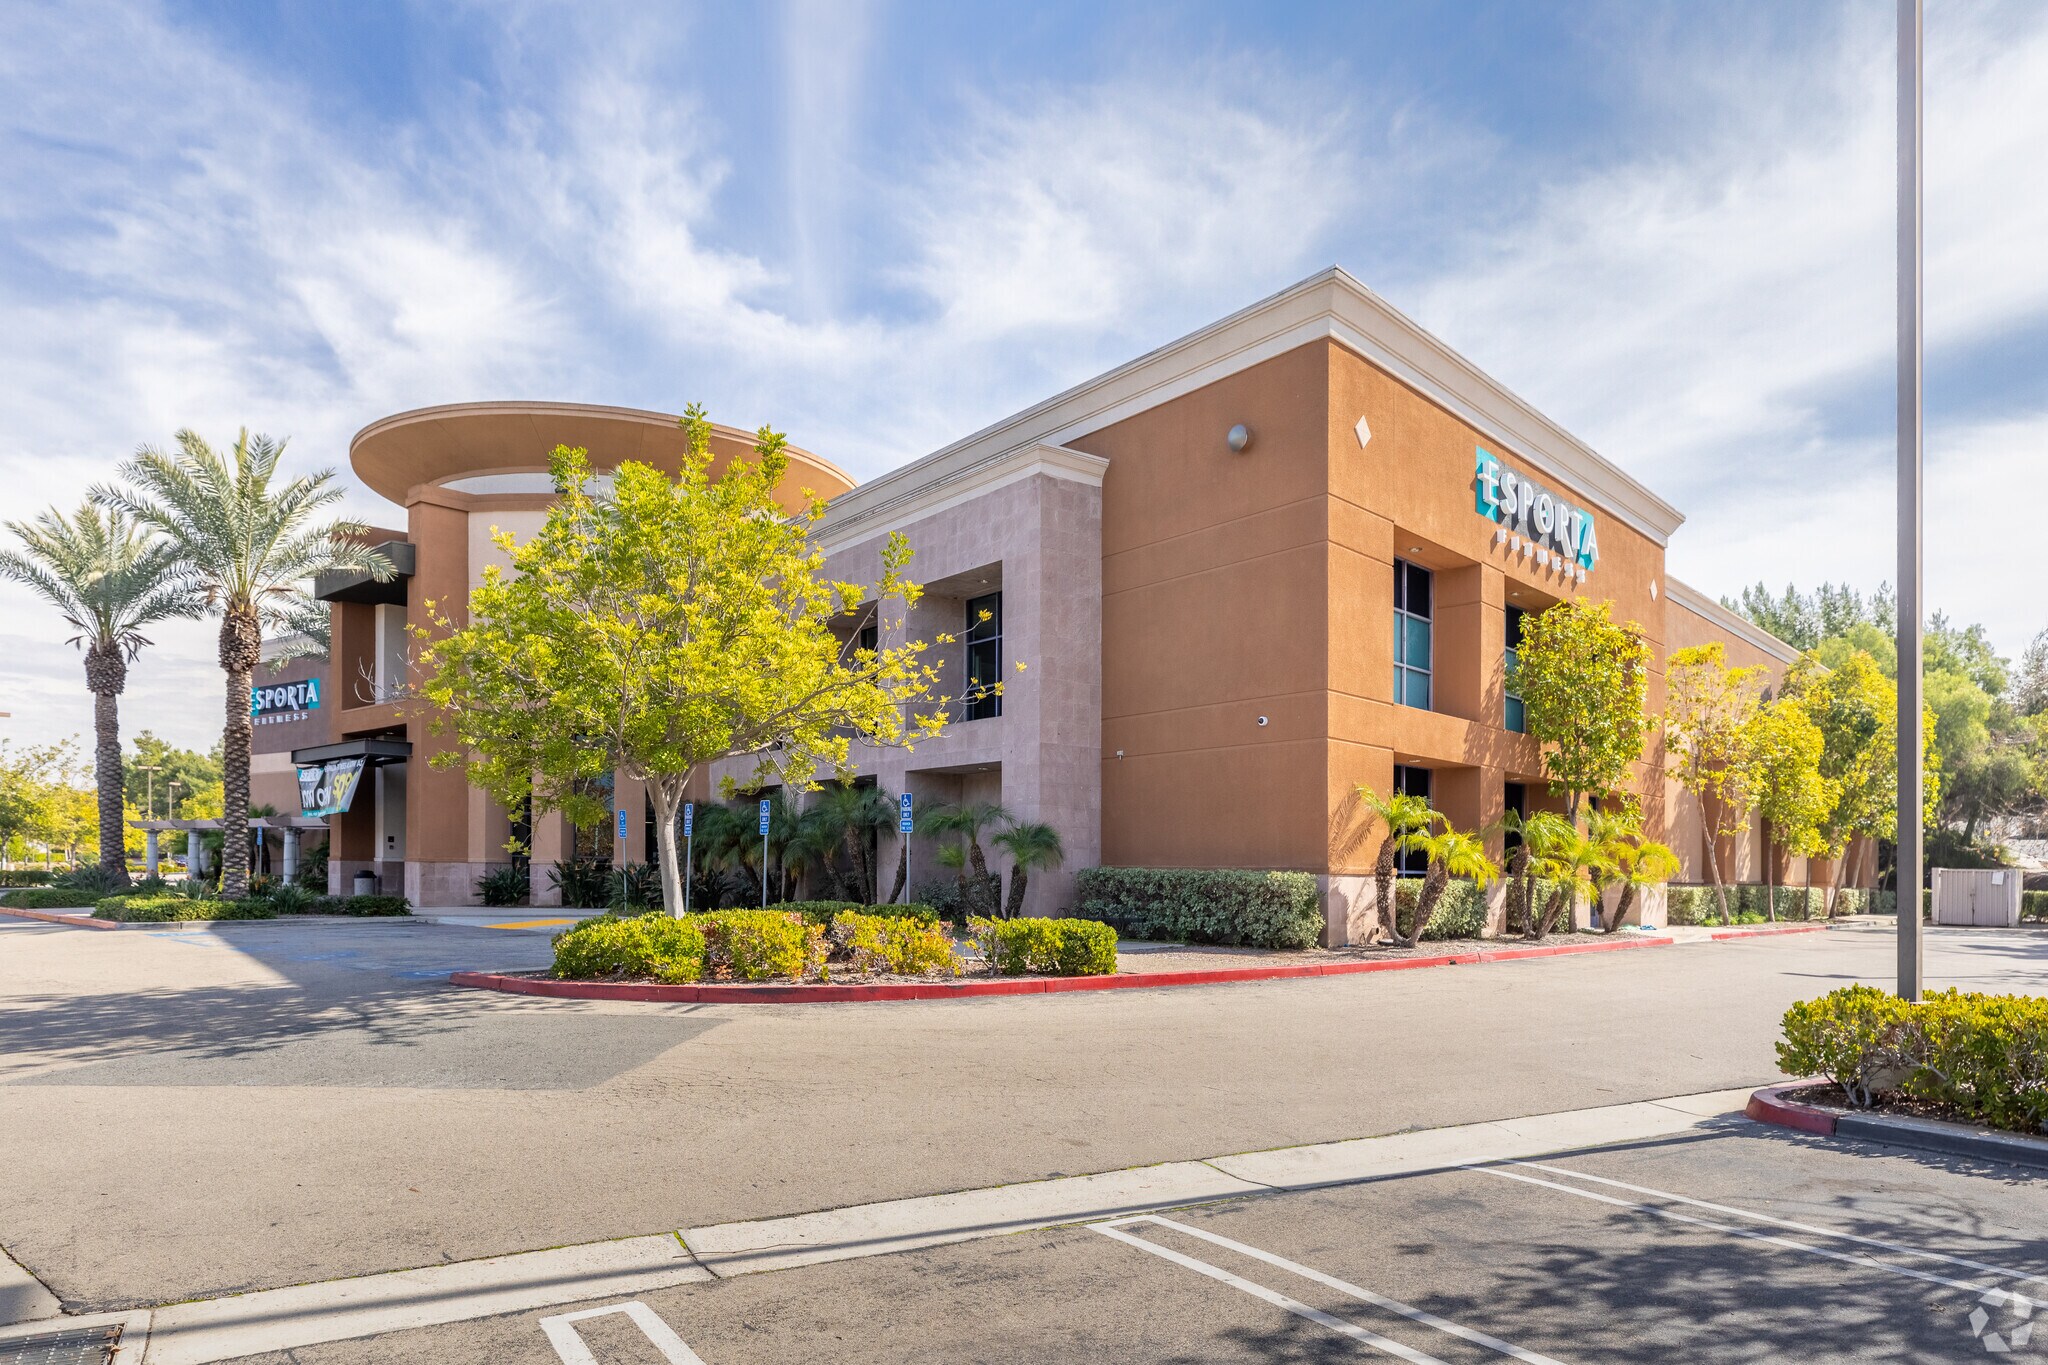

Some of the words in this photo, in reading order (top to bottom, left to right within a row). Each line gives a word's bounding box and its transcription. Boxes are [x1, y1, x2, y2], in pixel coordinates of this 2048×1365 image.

[1477, 460, 1600, 561] ESPORTA
[1496, 528, 1586, 584] FITNESS
[254, 712, 309, 726] FITNESS
